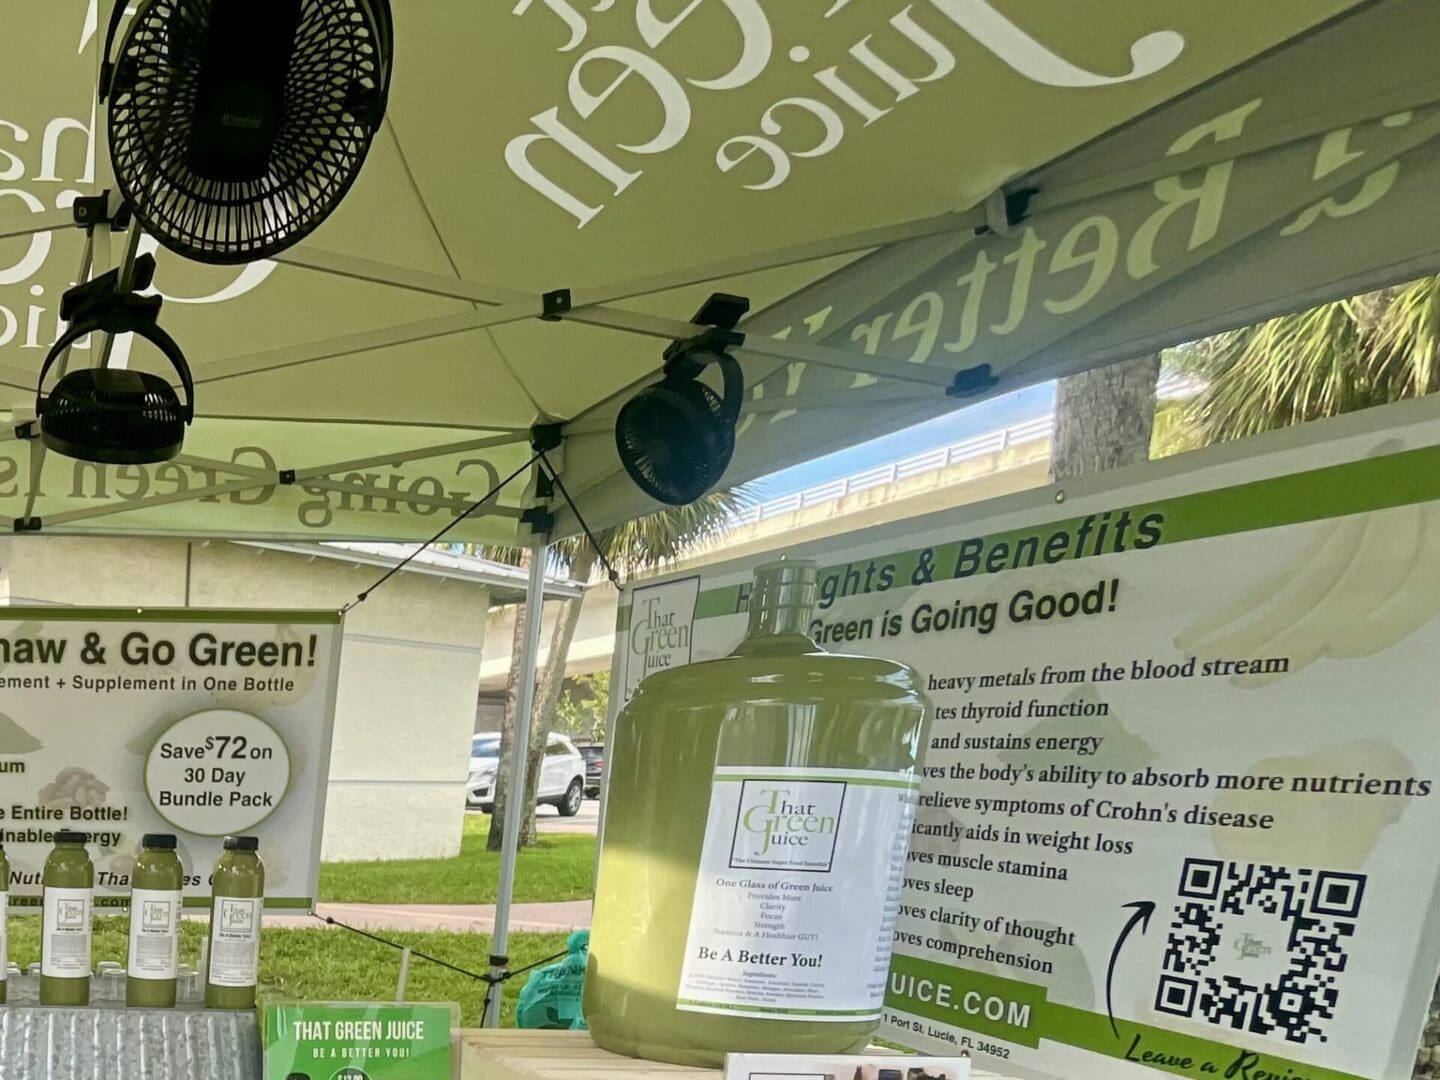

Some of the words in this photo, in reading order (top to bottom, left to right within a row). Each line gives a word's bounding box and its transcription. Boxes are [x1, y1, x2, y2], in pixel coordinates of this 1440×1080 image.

[911, 548, 936, 586] &
[954, 511, 1164, 580] Benefits
[643, 598, 675, 629] That
[809, 614, 873, 645] Green
[880, 609, 903, 637] is
[911, 600, 998, 635] Going
[1009, 578, 1120, 623] Good!
[80, 632, 107, 665] &
[121, 631, 175, 665] Go
[188, 633, 317, 667] Green!
[631, 620, 689, 655] Green
[72, 675, 175, 693] Supplement
[181, 676, 197, 691] in
[203, 676, 237, 692] One
[928, 674, 975, 693] heavy
[979, 667, 1036, 688] metals
[1040, 665, 1086, 685] from
[1091, 662, 1125, 682] the
[1131, 657, 1197, 681] blood
[1201, 657, 1290, 677] stream
[961, 700, 1022, 723] thyroid
[1027, 699, 1110, 718] function
[160, 743, 205, 759] Save
[205, 736, 247, 759] $72
[250, 747, 272, 759] on
[931, 733, 961, 749] and
[964, 733, 1031, 750] sustains
[1036, 736, 1104, 755] energy
[184, 768, 205, 783] 30
[212, 768, 245, 786] Day
[950, 763, 975, 780] the
[979, 763, 1034, 786] body's
[1038, 765, 1101, 789] ability
[1106, 769, 1127, 786] to
[1132, 767, 1210, 788] absorb
[1215, 773, 1284, 792] more
[1290, 773, 1433, 797] nutrients
[11, 805, 64, 820] Entire
[69, 806, 128, 821] Bottle!
[160, 791, 223, 806] Bundle
[229, 792, 273, 807] Pack
[760, 789, 816, 816] That
[919, 791, 971, 810] relieve
[974, 797, 1065, 818] symptoms
[1070, 799, 1093, 818] of
[1096, 800, 1178, 823] Crohn's
[1184, 804, 1274, 829] disease
[743, 804, 835, 835] Green
[755, 830, 808, 855] Juice
[965, 824, 1000, 842] aids
[1004, 826, 1021, 844] in
[1026, 829, 1091, 853] weight
[1094, 833, 1134, 855] loss
[937, 853, 994, 871] muscle
[997, 860, 1069, 881] stamina
[780, 882, 810, 891] Green
[812, 883, 833, 892] Juice
[933, 879, 974, 902] sleep
[929, 909, 981, 933] clarity
[984, 915, 1005, 933] of
[1005, 919, 1076, 947] thought
[698, 946, 718, 960] Be
[721, 949, 733, 961] A
[738, 950, 787, 965] Better
[791, 953, 823, 968] You!
[925, 935, 1053, 974] comprehension
[293, 1021, 332, 1040] THAT
[335, 1021, 382, 1040] GREEN
[386, 1020, 424, 1040] JUICE
[890, 1015, 910, 1029] Port
[912, 1022, 925, 1034] St.
[927, 1026, 958, 1046] Lucie,
[960, 1036, 974, 1049] FL
[977, 1041, 1010, 1060] 34952
[313, 1048, 325, 1058] BE
[330, 1048, 337, 1058] A
[342, 1048, 380, 1058] BETTER
[386, 1047, 410, 1058] YOU!
[1124, 1033, 1196, 1070] Leave
[1200, 1060, 1218, 1074] a
